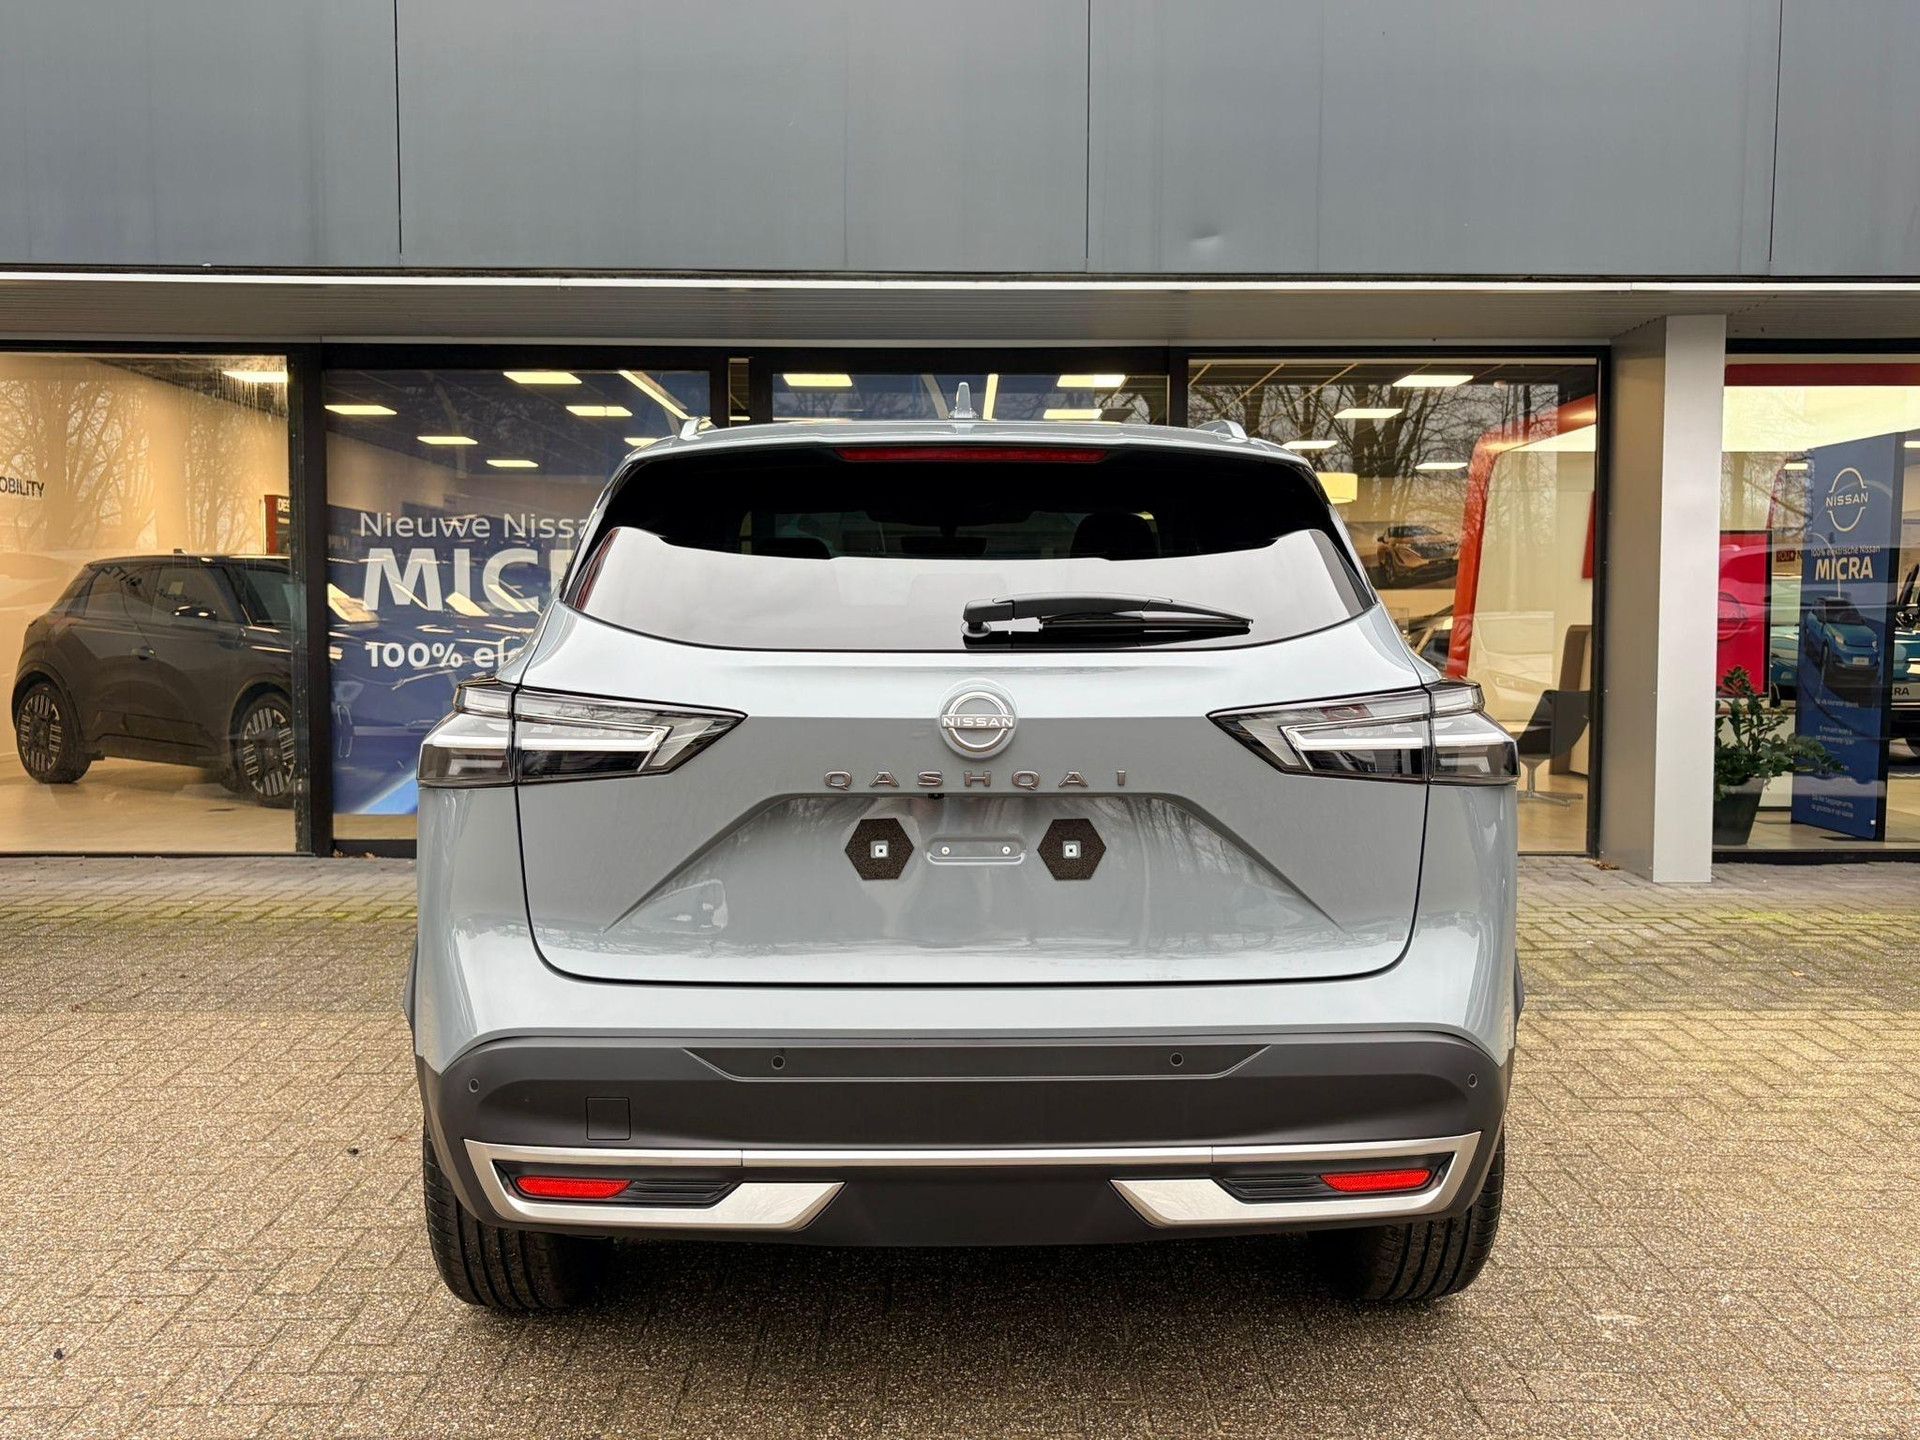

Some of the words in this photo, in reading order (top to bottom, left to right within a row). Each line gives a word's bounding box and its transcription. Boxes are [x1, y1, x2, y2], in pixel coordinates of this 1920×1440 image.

[1825, 491, 1869, 507] NISSAN
[360, 512, 490, 538] Nieuwe
[362, 547, 573, 611] MIC
[1815, 556, 1873, 581] MICRA
[366, 642, 462, 668] 100%
[942, 715, 1014, 728] NISSAN
[823, 769, 1127, 791] QASHQAI
